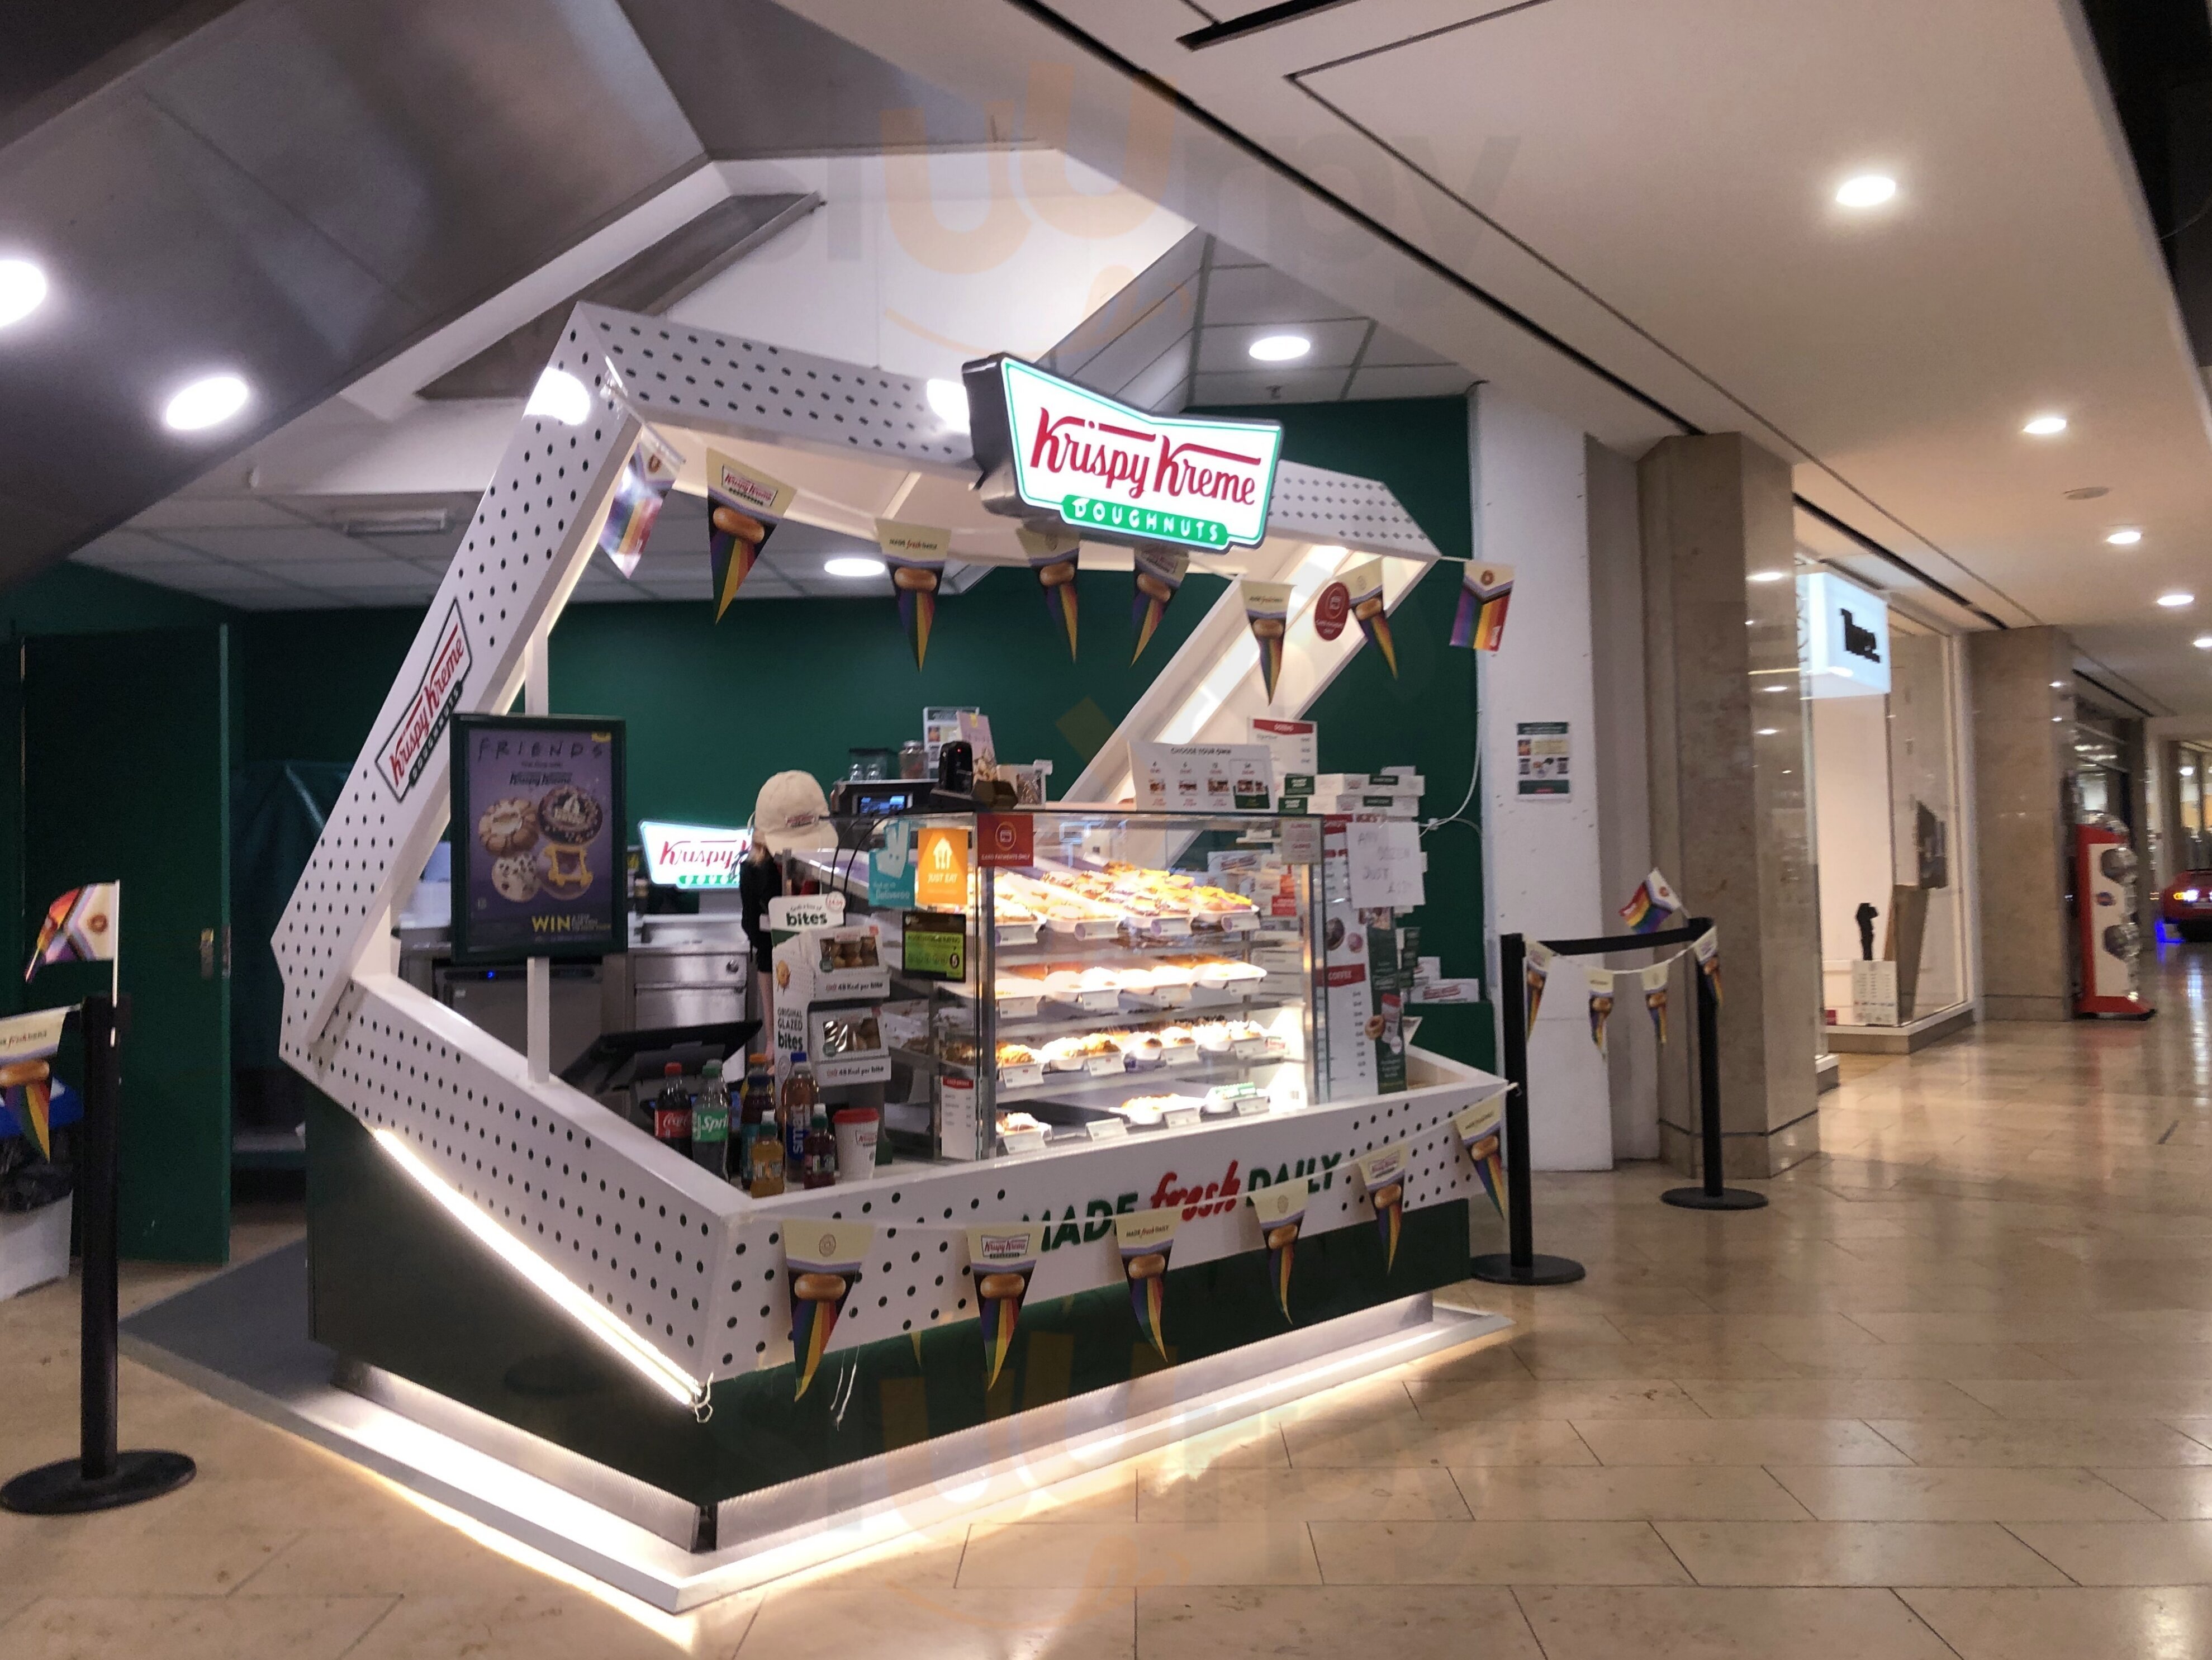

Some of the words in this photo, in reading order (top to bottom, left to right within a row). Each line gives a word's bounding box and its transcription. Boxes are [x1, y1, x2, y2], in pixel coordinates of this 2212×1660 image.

[1029, 406, 1156, 499] Krispy
[1152, 434, 1261, 505] Kreme
[1071, 497, 1219, 542] DOUGHNUTS
[389, 695, 430, 788] Krispy
[423, 622, 464, 717] Kreme
[659, 840, 737, 870] Krispy
[928, 873, 944, 884] JUST
[944, 872, 958, 884] EAT
[531, 914, 571, 933] WIN
[786, 912, 828, 926] bites
[777, 1007, 803, 1018] ORIGINAL
[777, 1018, 803, 1032] GLAZED
[777, 1031, 803, 1051] bites
[1150, 1159, 1241, 1222] fresh
[984, 1240, 1006, 1253] Krispy
[1005, 1240, 1027, 1252] Kreme
